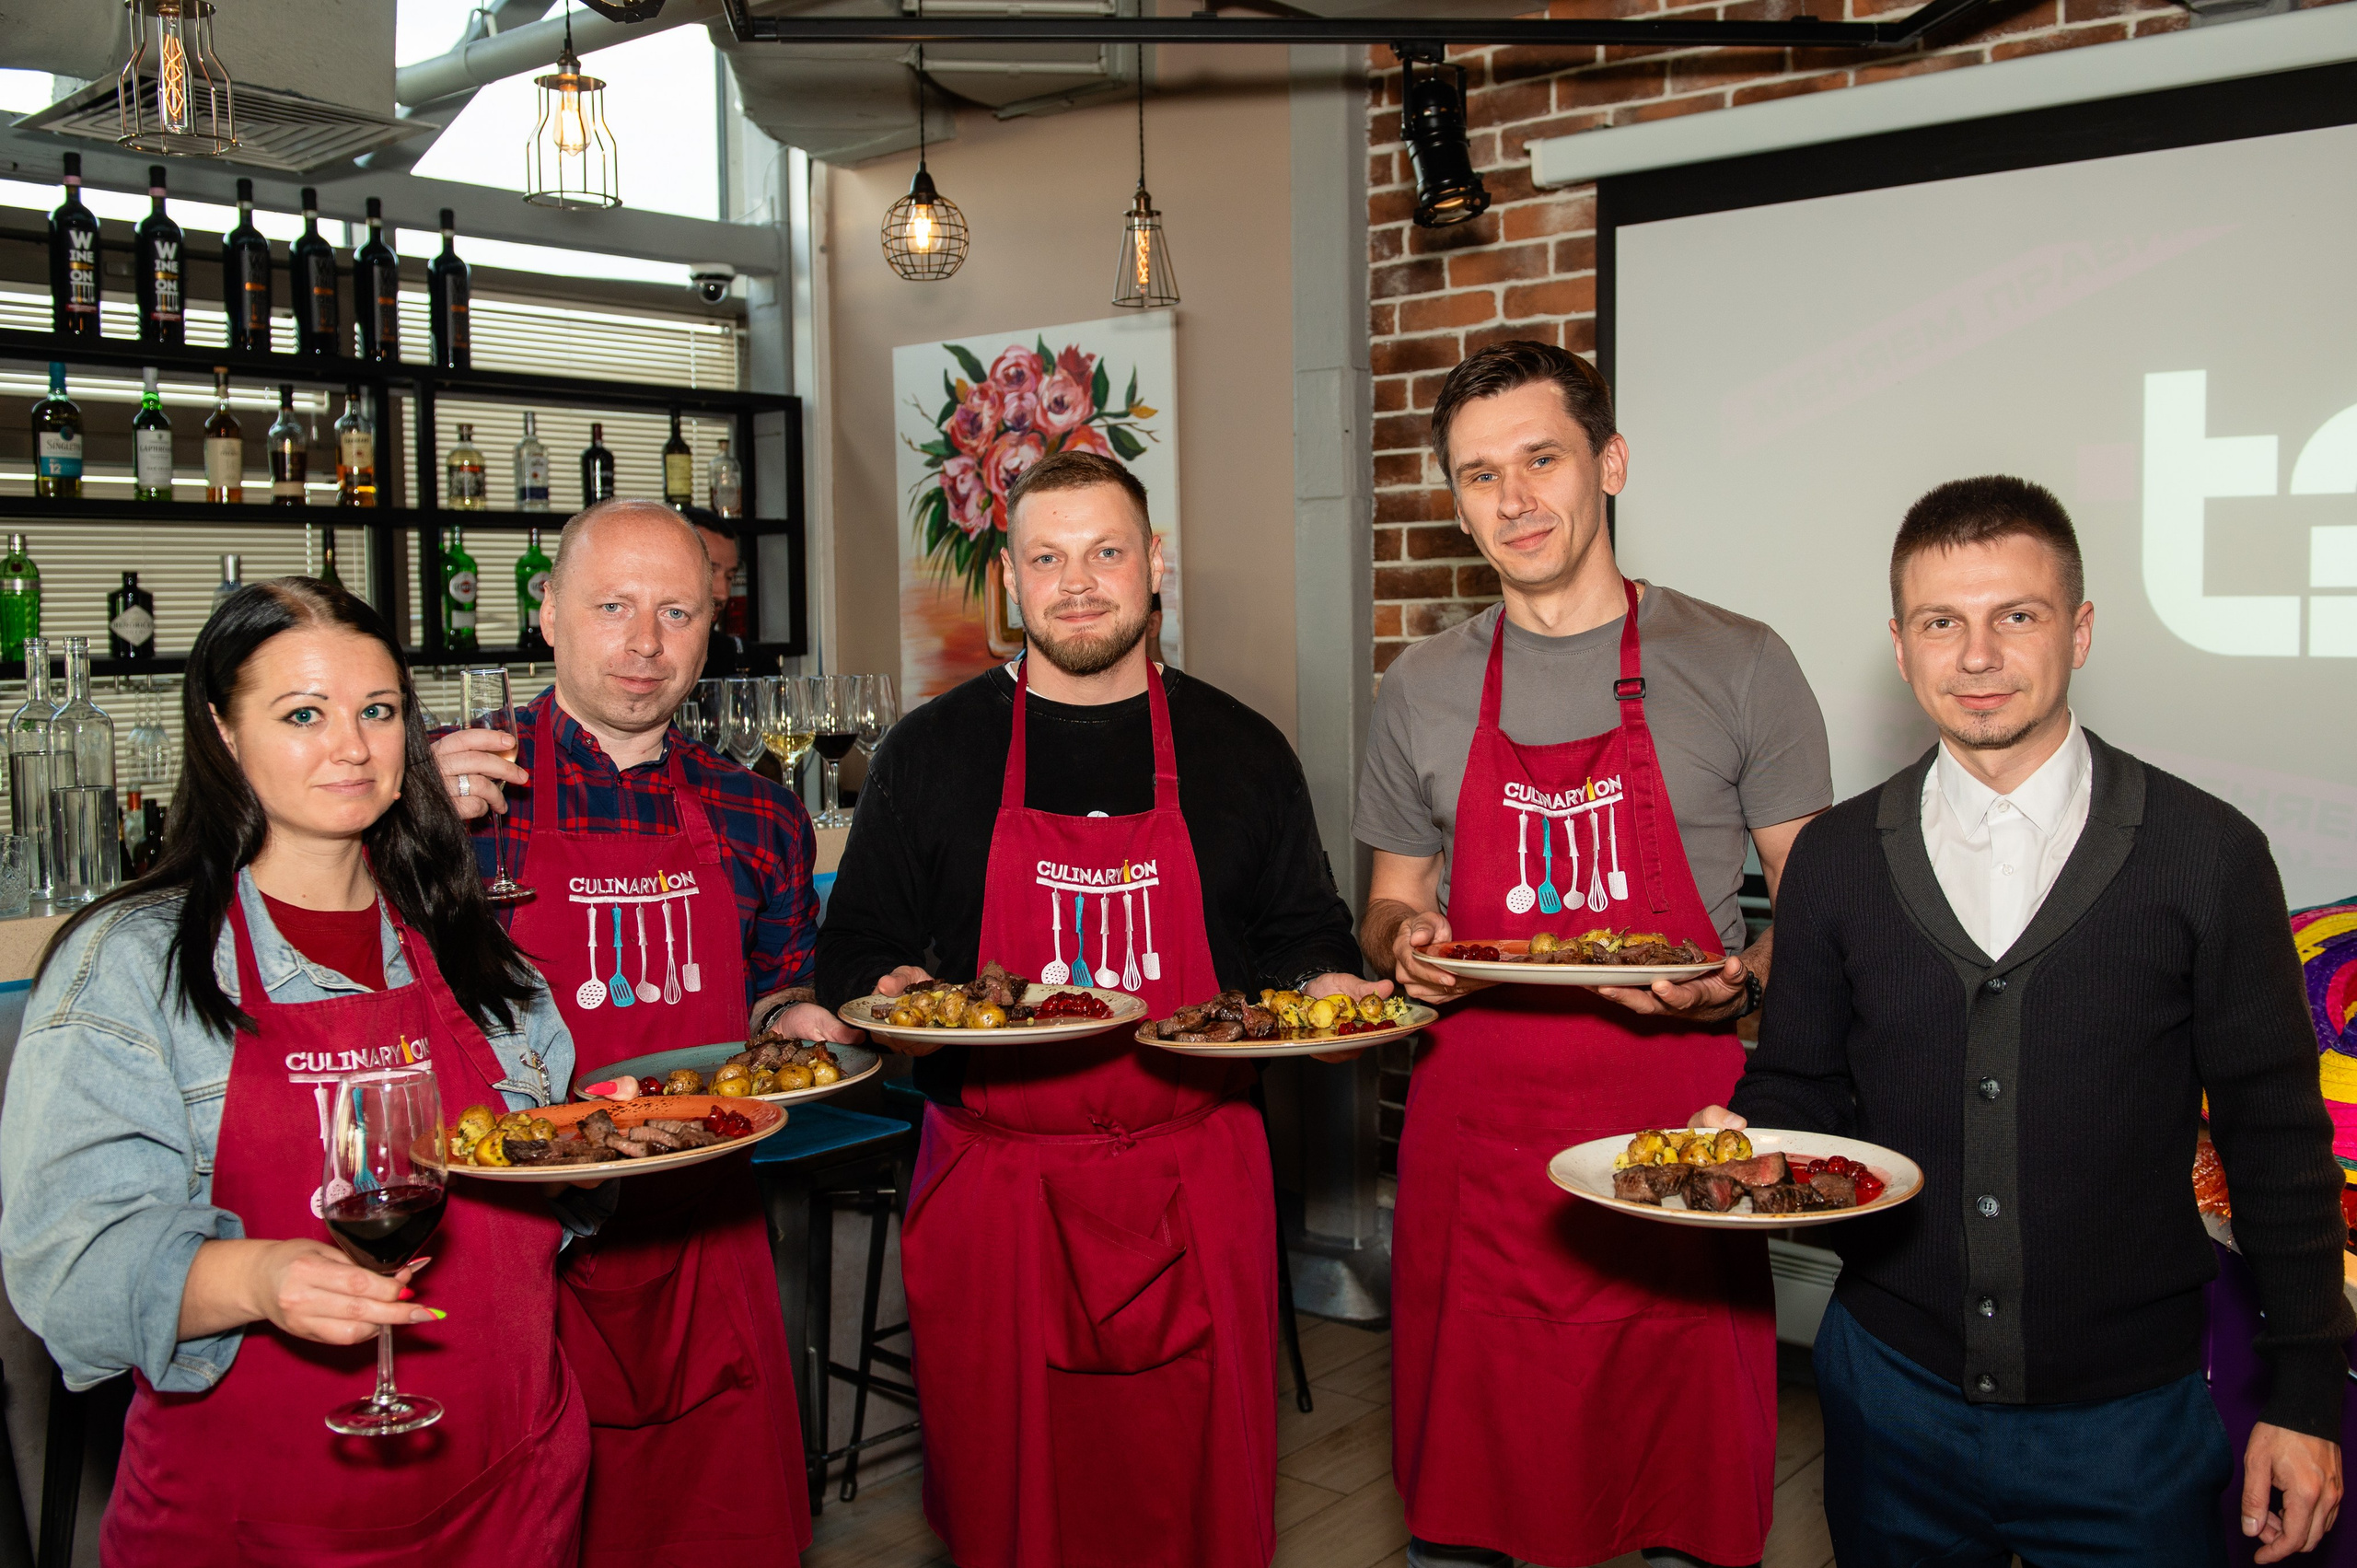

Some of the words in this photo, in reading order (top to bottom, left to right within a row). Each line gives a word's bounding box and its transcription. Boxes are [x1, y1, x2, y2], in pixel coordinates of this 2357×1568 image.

[70, 270, 94, 283] ON
[155, 279, 178, 291] ON
[49, 462, 62, 475] 12
